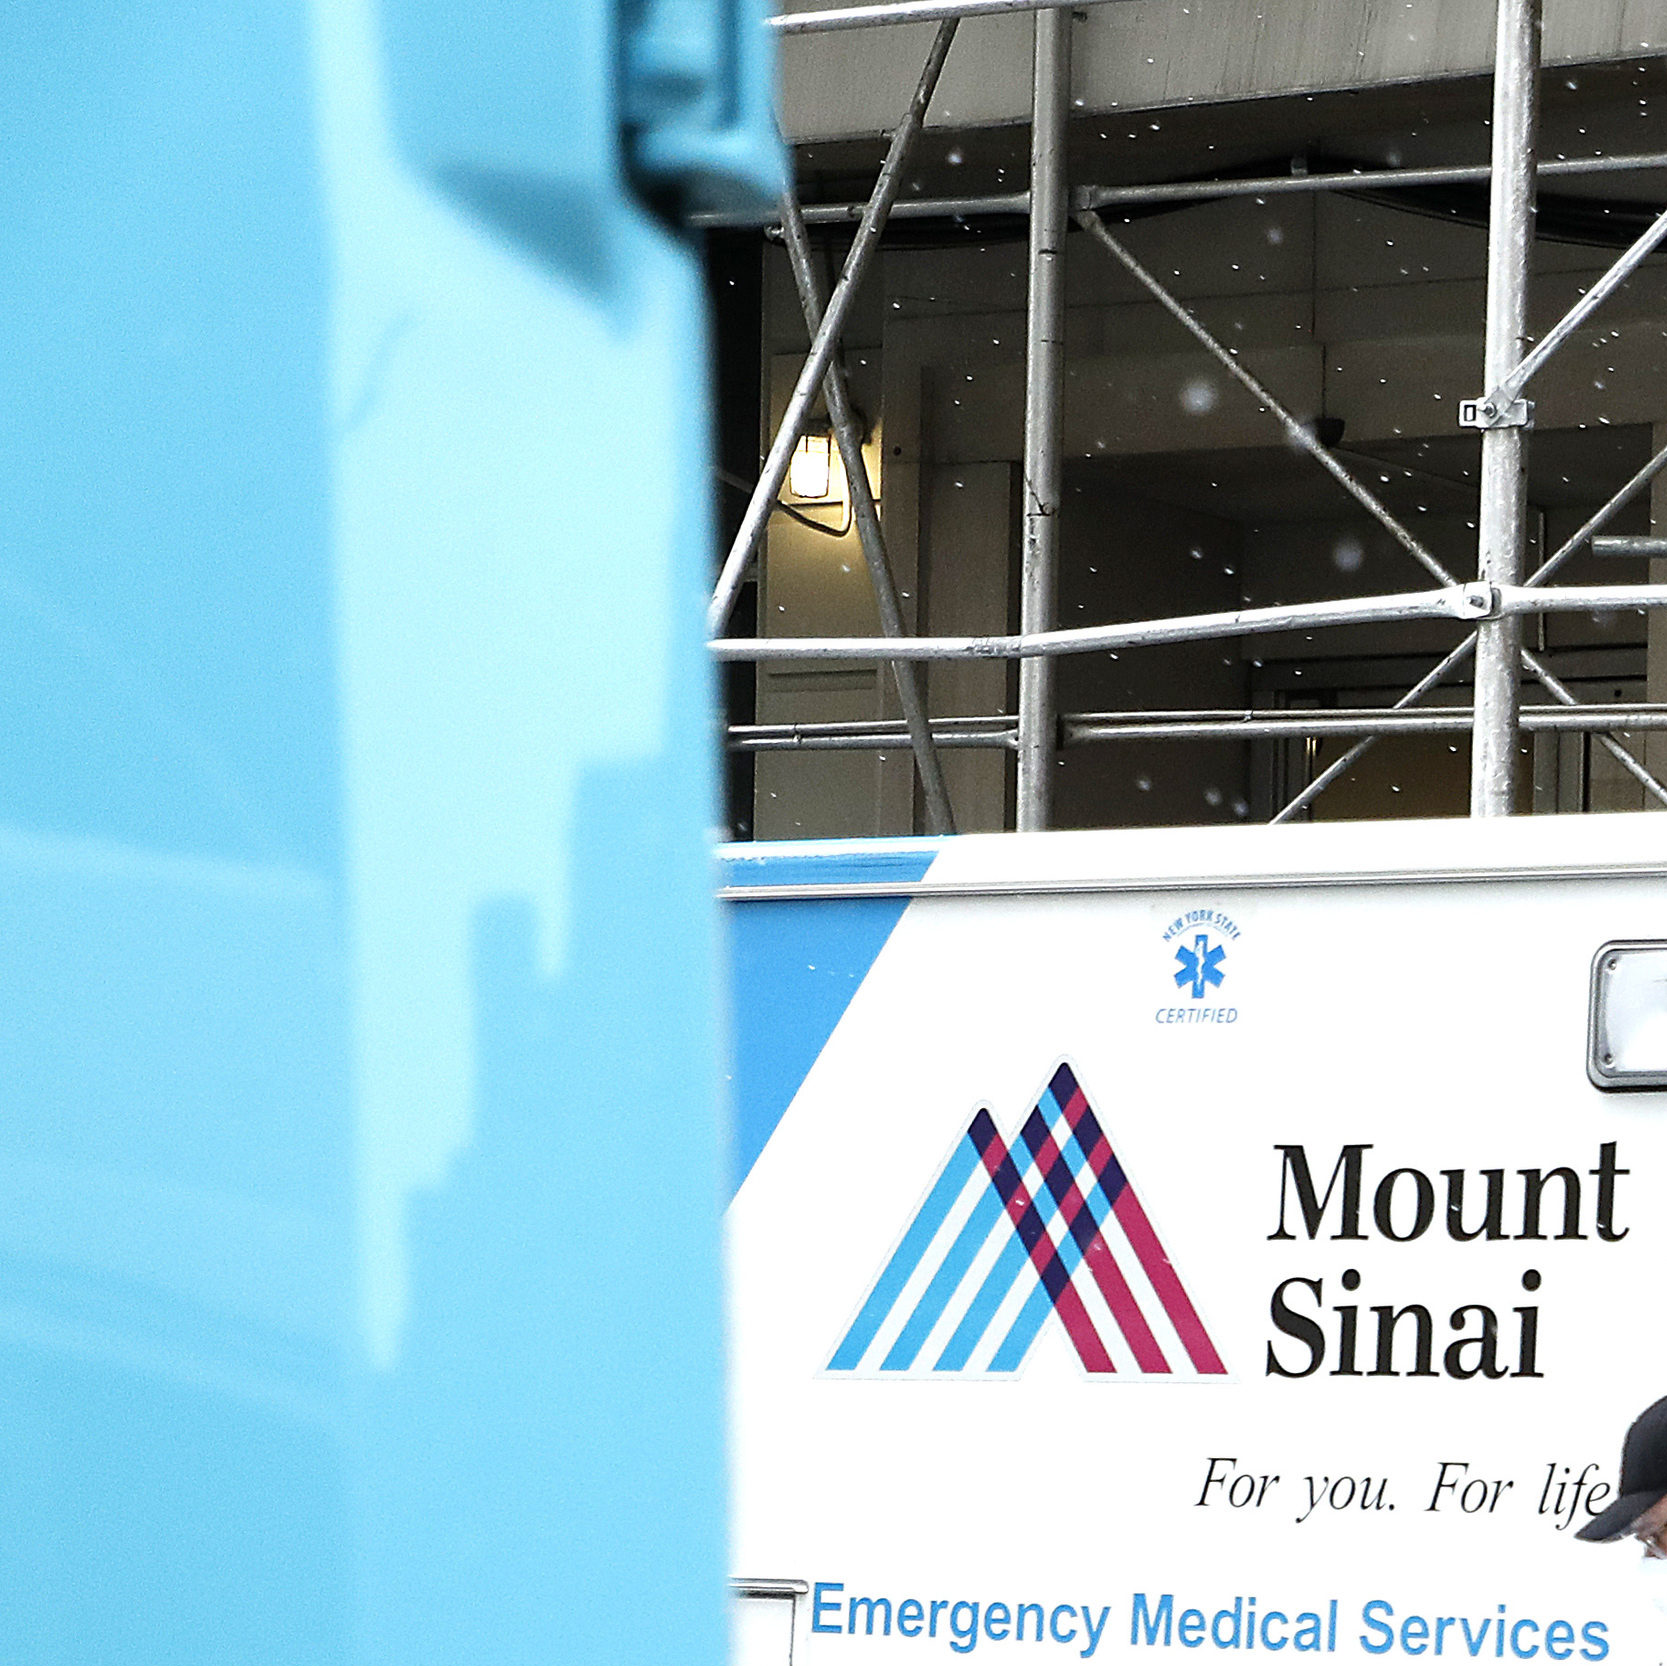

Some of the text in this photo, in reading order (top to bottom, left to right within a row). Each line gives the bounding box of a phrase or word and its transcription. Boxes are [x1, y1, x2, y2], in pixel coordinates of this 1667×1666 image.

[1162, 909, 1241, 943] NEW YORK STATE
[1155, 1007, 1239, 1024] CERTIFIED
[1266, 1141, 1631, 1243] Mount
[1265, 1268, 1545, 1380] Sinai
[1193, 1457, 1611, 1531] For you. For life
[811, 1582, 1611, 1663] Emergency Medical Services
